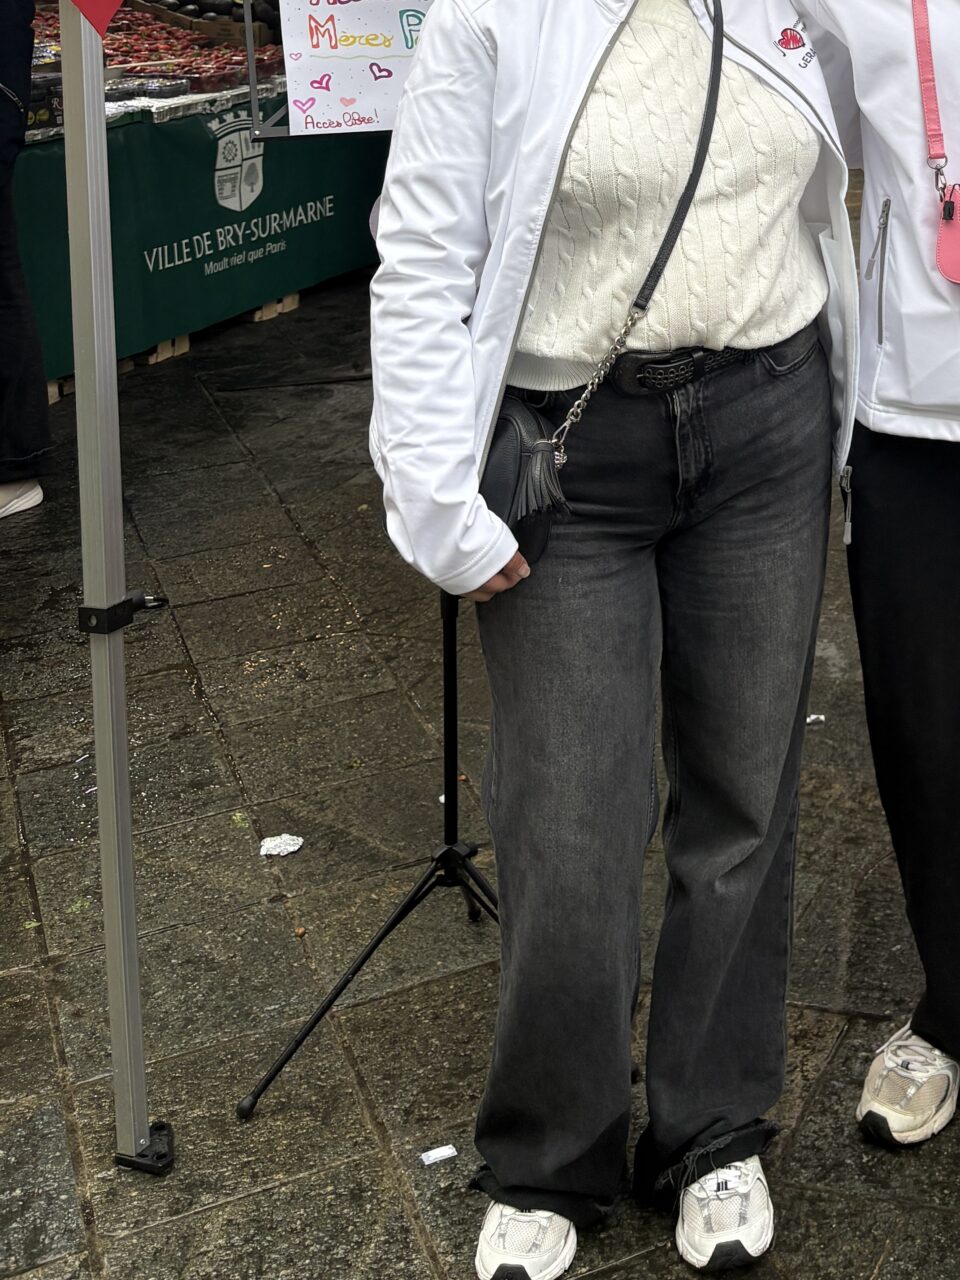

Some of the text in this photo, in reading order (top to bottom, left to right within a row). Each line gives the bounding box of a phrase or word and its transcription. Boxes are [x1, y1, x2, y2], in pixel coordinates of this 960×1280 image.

[308, 14, 394, 49] Mères
[305, 114, 343, 129] Accès
[144, 195, 335, 272] VILLE DE BRY-SUR-MARNE
[204, 258, 230, 276] Moult
[247, 247, 264, 264] que
[265, 239, 287, 256] Paris
